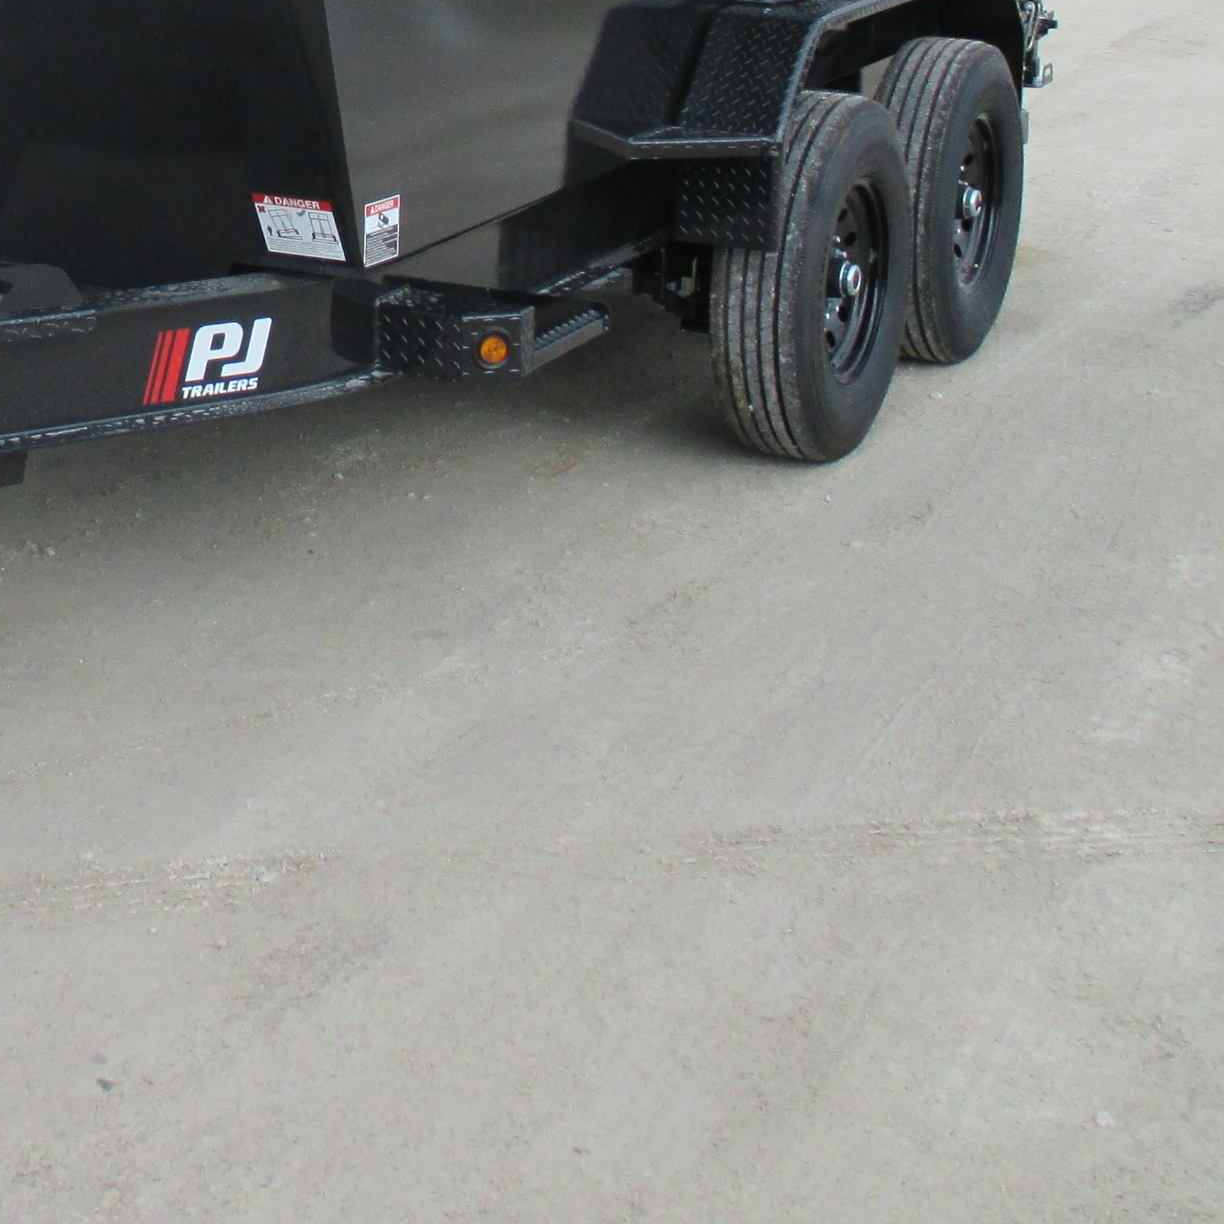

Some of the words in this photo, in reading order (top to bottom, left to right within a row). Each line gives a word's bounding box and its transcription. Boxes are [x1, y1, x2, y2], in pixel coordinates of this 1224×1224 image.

[274, 196, 321, 210] DANGER
[375, 199, 395, 212] DANGER
[185, 317, 273, 383] PJ
[182, 377, 259, 400] TRAILERS
